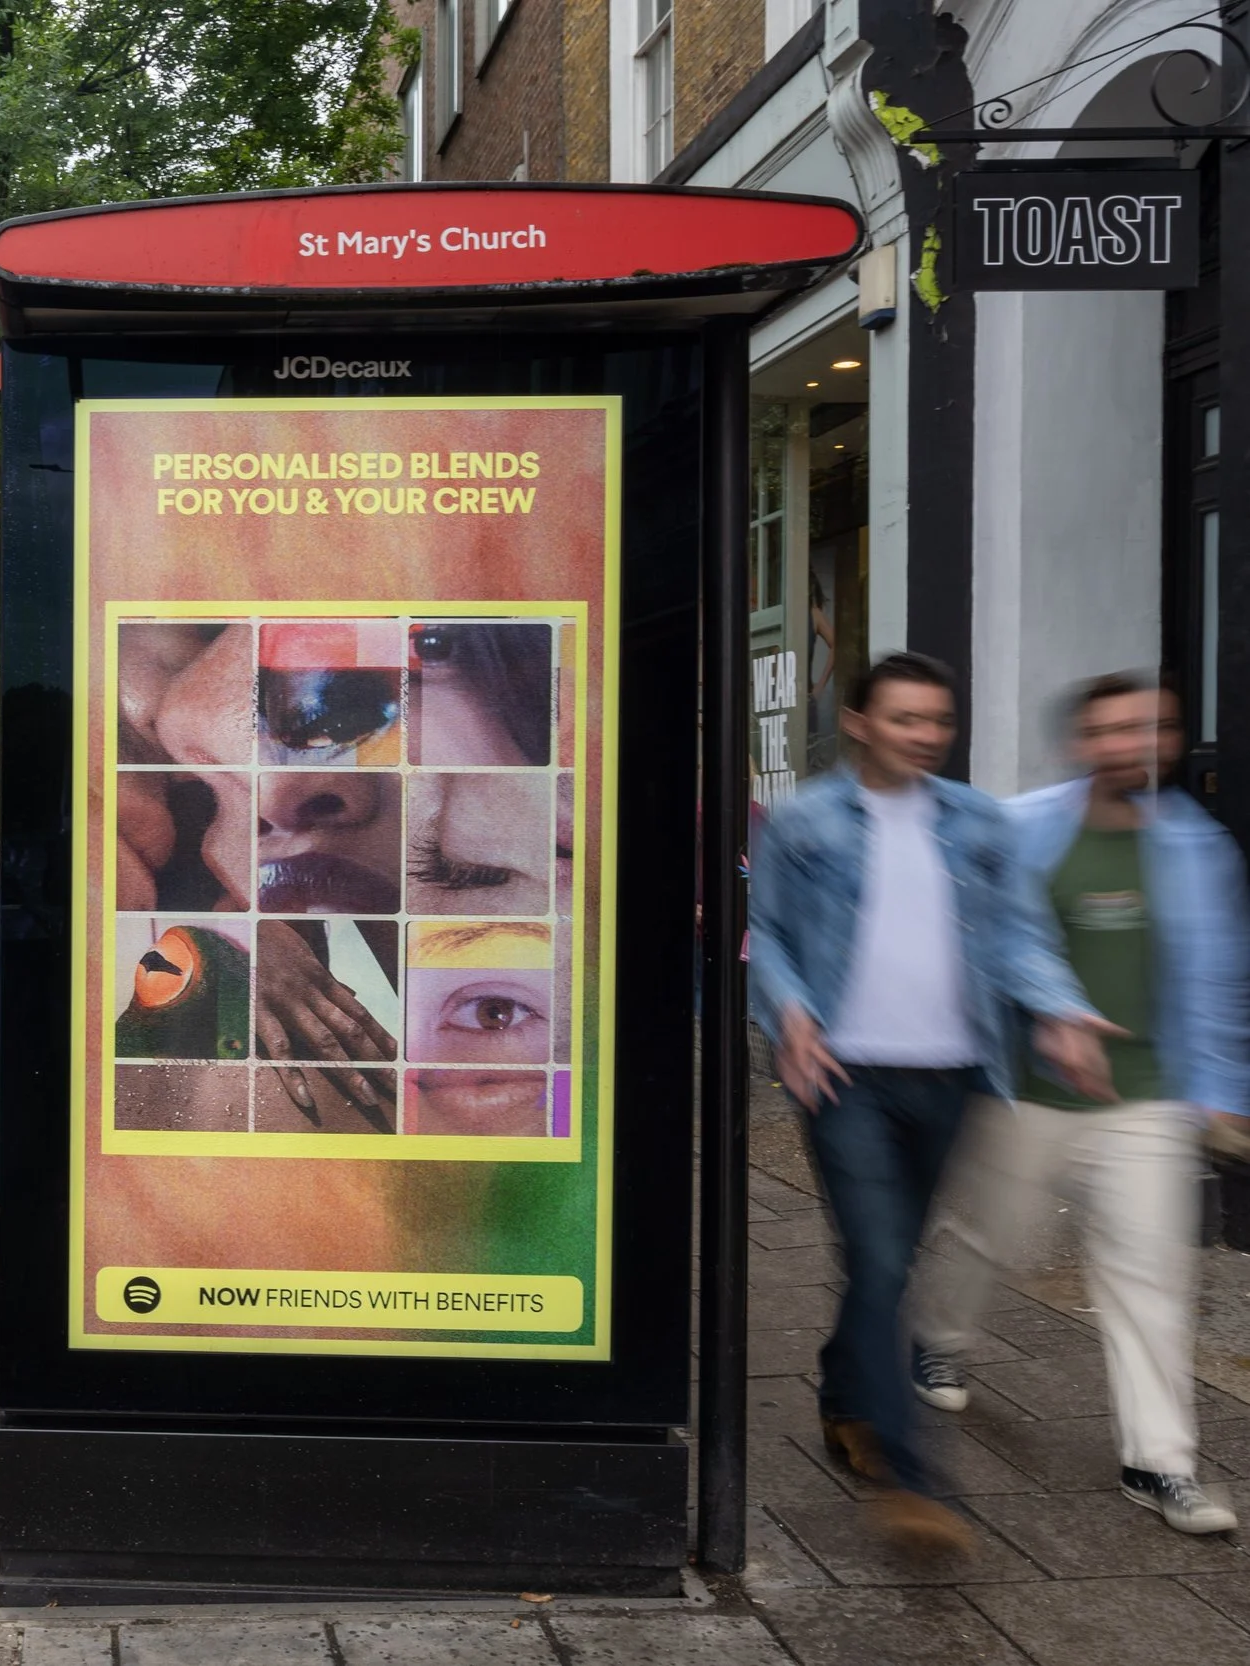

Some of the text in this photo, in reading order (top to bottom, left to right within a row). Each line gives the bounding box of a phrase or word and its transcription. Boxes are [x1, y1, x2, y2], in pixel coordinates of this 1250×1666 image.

[298, 224, 547, 258] St Mary's Church
[973, 195, 1182, 266] TOAST
[273, 356, 412, 380] JCDecaux
[153, 452, 541, 481] PERSONALISED BLENDS
[157, 487, 536, 516] FOR YOU & YOUR CREW
[753, 651, 797, 713] WEAR
[759, 713, 788, 772] THE
[198, 1287, 544, 1313] NOW FRIENDS WITH BENEFITS
